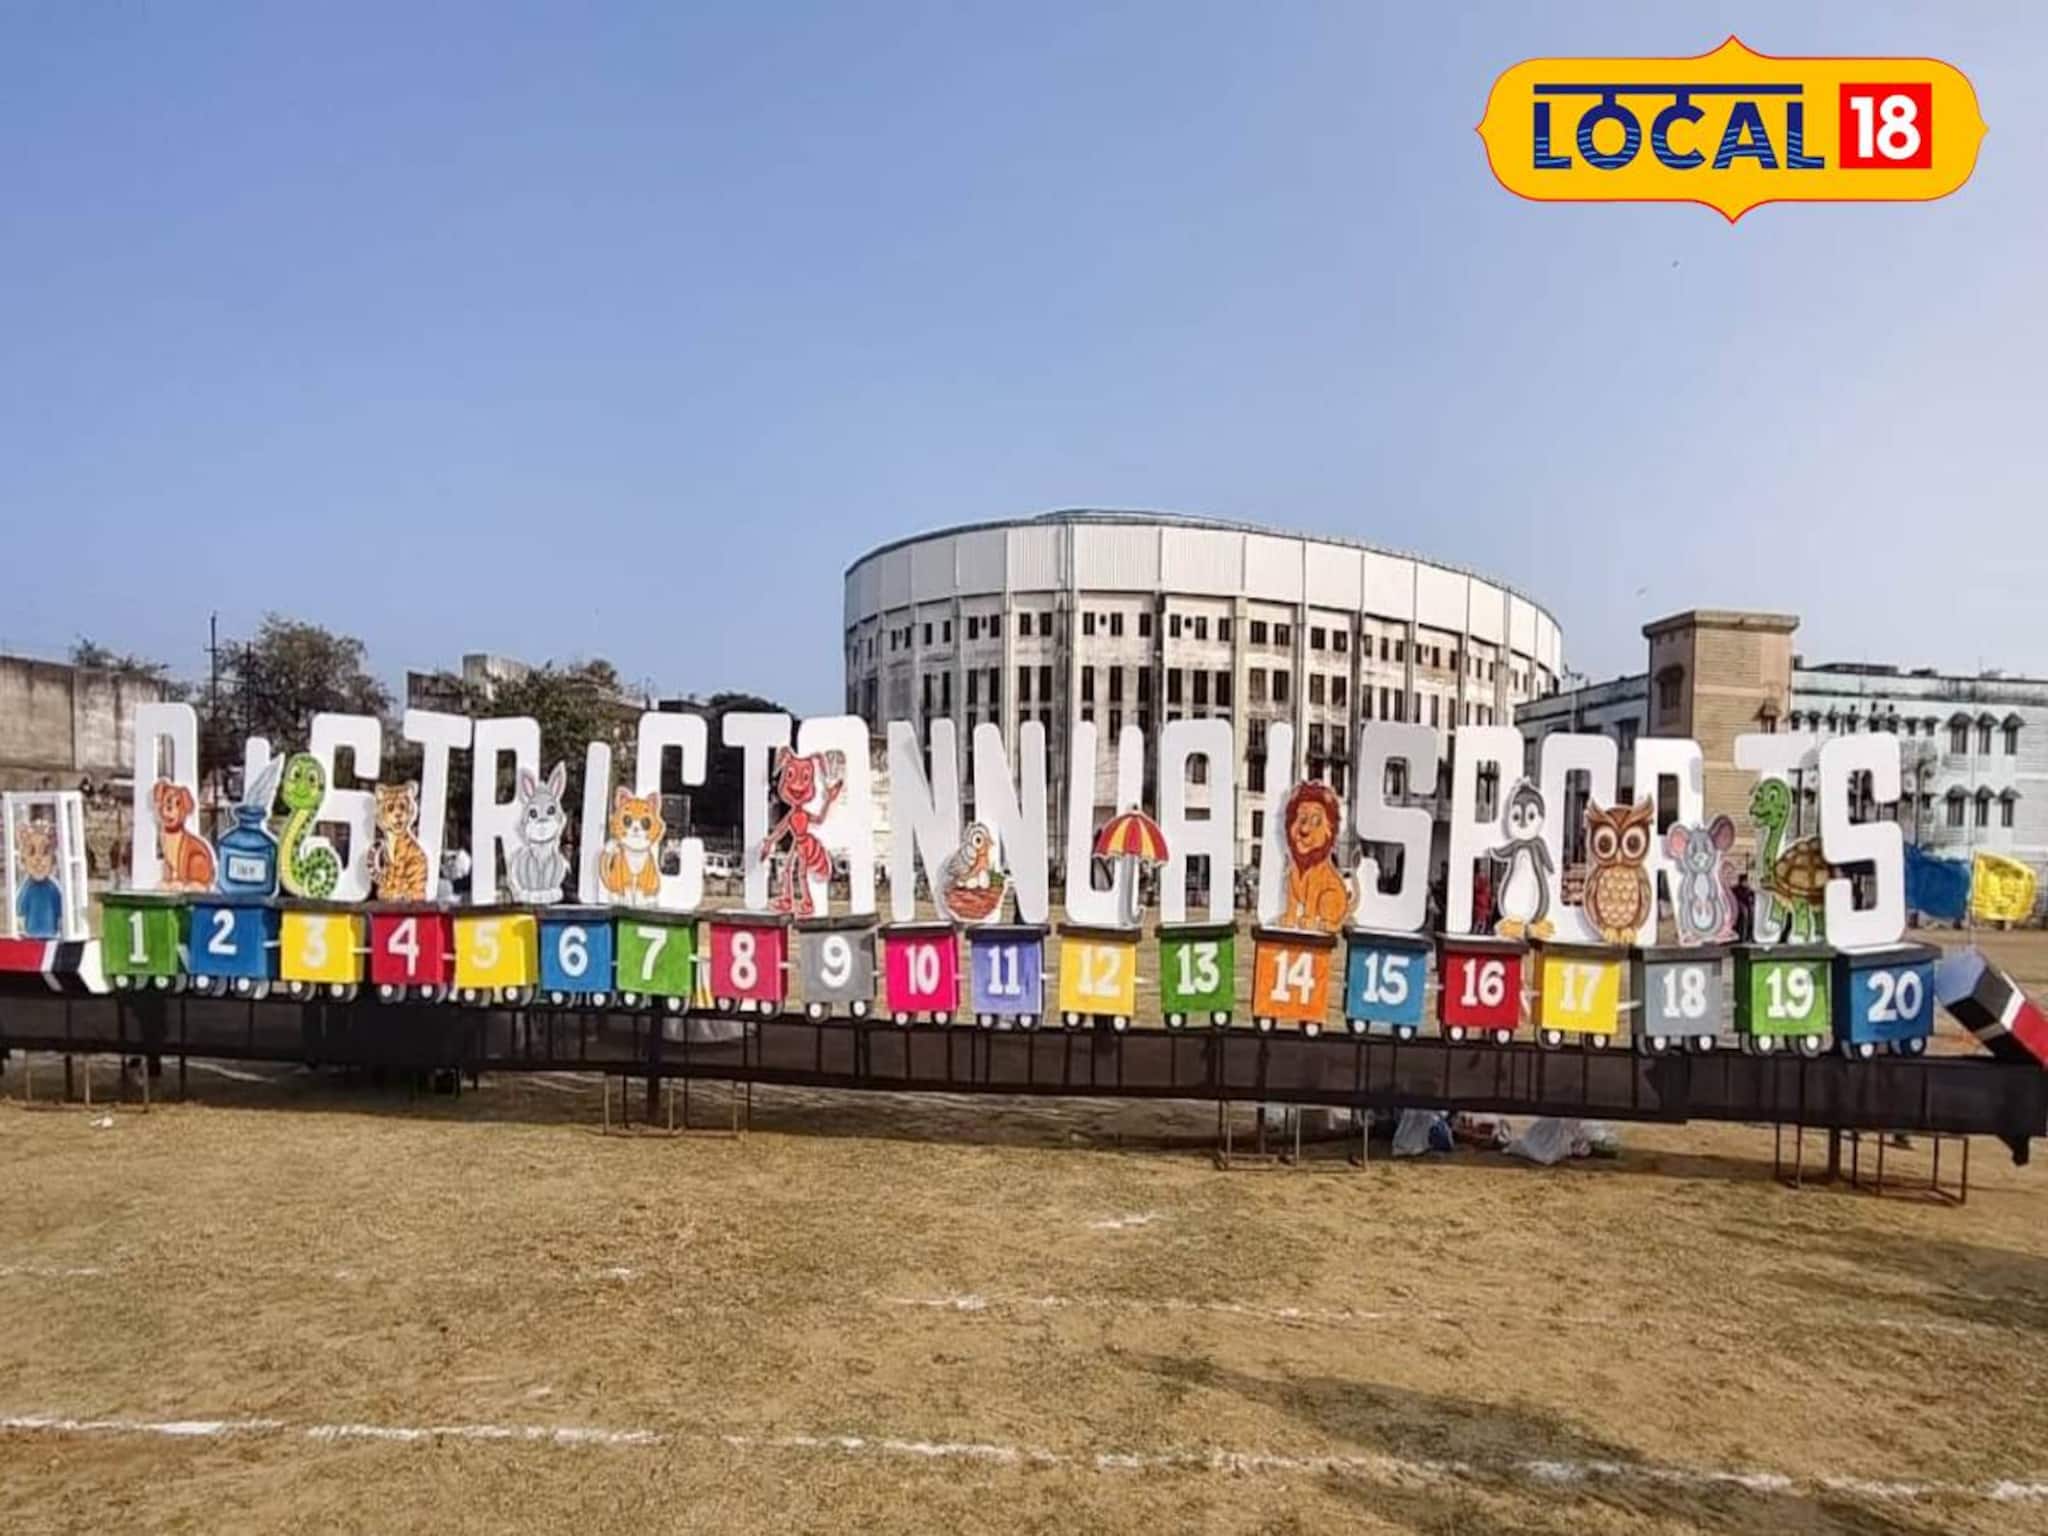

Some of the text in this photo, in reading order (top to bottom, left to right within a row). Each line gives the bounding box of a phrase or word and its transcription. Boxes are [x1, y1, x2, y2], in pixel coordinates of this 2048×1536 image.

[128, 911, 149, 963] 1
[208, 910, 237, 955] 2
[303, 911, 327, 966] 3
[387, 917, 418, 976] 4
[472, 920, 500, 969] 5
[557, 926, 588, 977] 6
[636, 926, 668, 981] 7
[730, 931, 757, 990] 8
[821, 936, 853, 989] 9
[907, 945, 941, 994] 10
[987, 943, 1021, 994] 11
[1079, 950, 1120, 996] 12
[1177, 943, 1219, 995] 13
[1272, 952, 1315, 1003] 14
[1363, 953, 1409, 1004] 15
[1461, 959, 1505, 1007] 16
[1560, 966, 1603, 1013] 17
[1661, 967, 1708, 1017] 18
[1764, 966, 1815, 1019] 19
[1867, 971, 1922, 1022] 20
